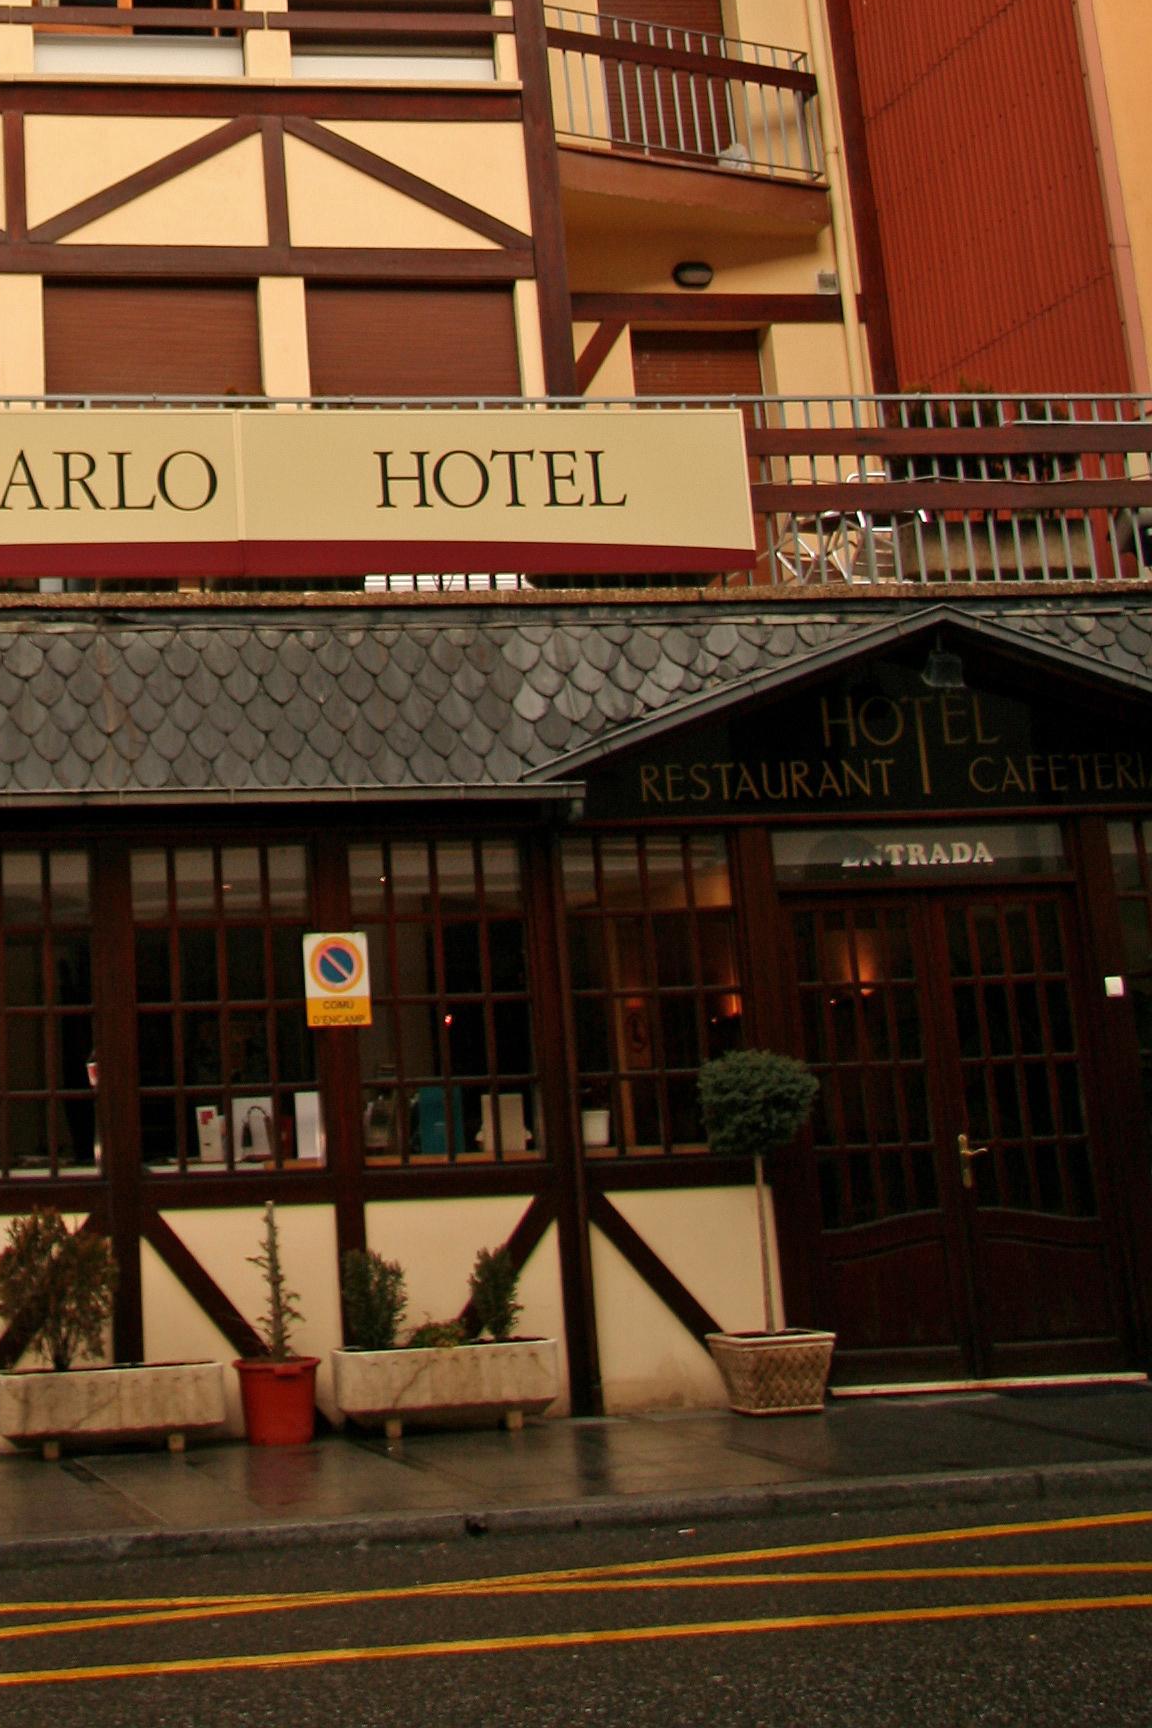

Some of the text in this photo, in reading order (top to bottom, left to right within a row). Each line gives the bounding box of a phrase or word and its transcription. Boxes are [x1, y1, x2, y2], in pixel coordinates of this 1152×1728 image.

[372, 448, 628, 509] HOTEL
[818, 692, 1000, 796] HOTEL
[639, 750, 1152, 803] RESTAURANT CAFETERI
